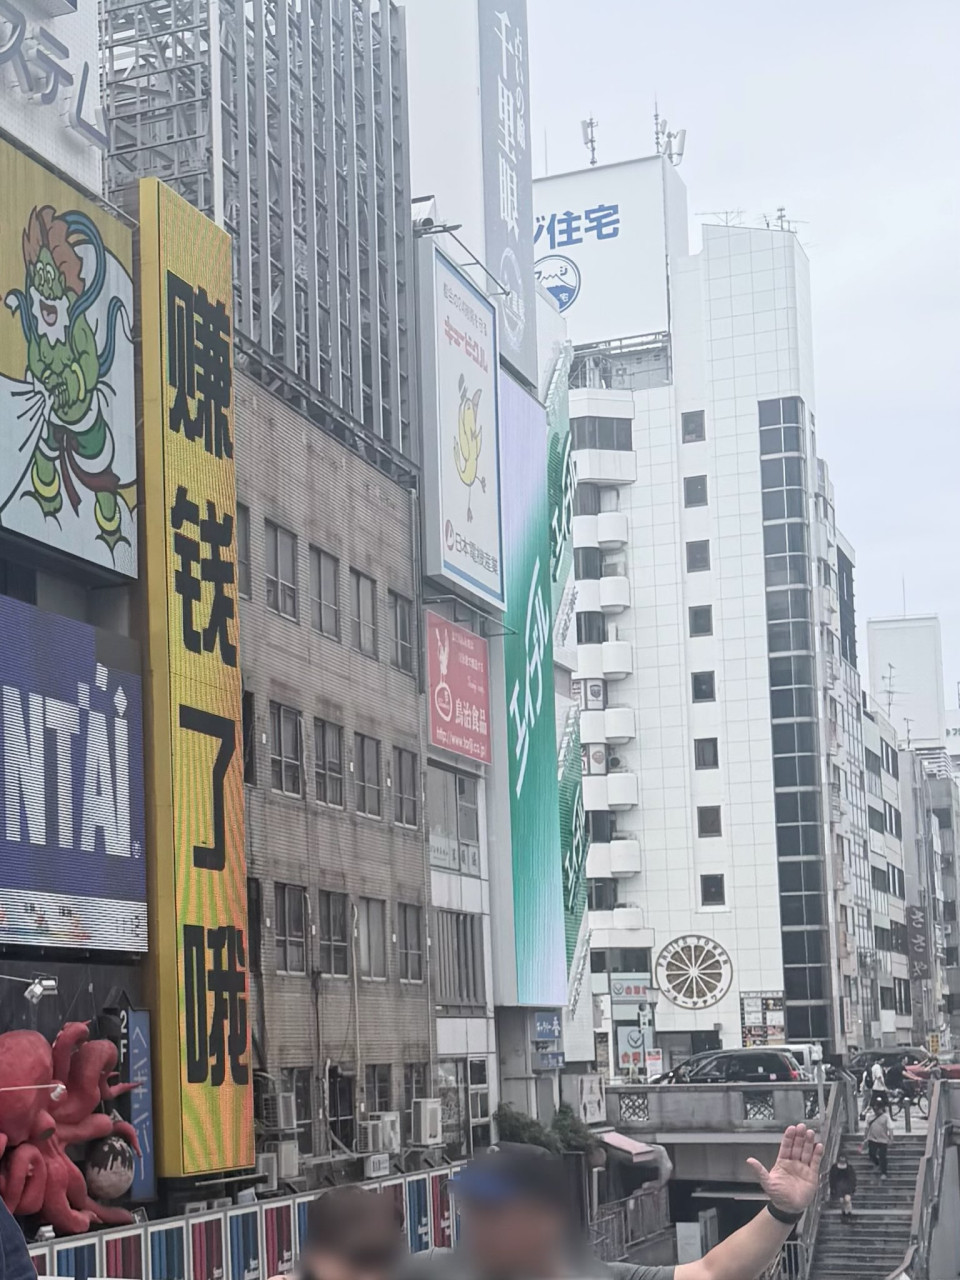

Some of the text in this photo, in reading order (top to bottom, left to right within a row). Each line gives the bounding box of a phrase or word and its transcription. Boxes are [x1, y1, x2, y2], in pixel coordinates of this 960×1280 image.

[494, 10, 520, 241] 千里眼
[120, 1010, 128, 1063] 2F
